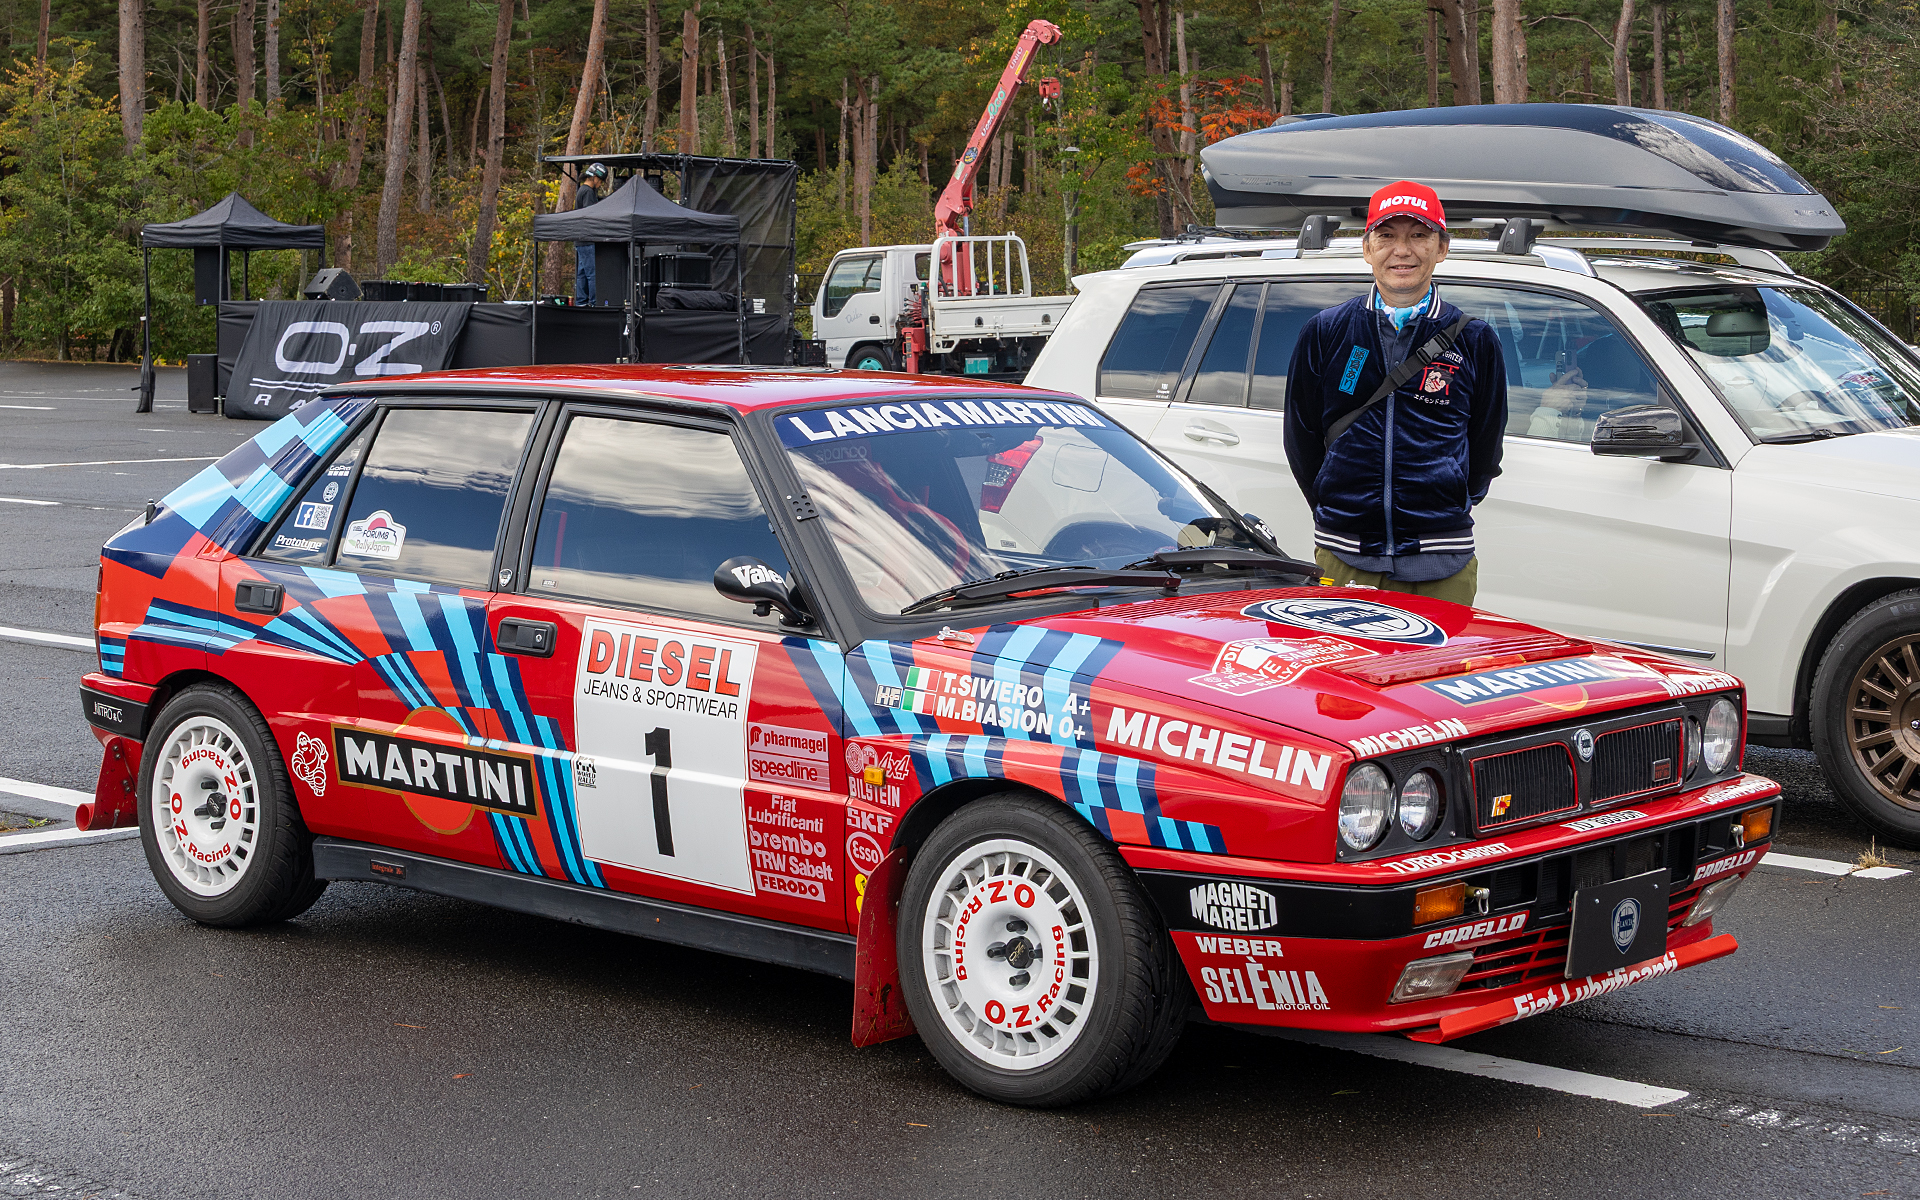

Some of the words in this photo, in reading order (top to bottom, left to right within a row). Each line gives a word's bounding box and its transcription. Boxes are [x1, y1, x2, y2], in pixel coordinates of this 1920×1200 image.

[1010, 47, 1023, 69] UNIC
[1379, 196, 1428, 211] MOTUL
[789, 402, 953, 442] LANCIA
[943, 401, 1107, 428] MARTINI
[275, 534, 322, 552] Prototype
[731, 565, 788, 589] Vale
[587, 629, 741, 697] DIESEL
[1278, 643, 1354, 661] SANREMO
[1216, 660, 1282, 689] RALLYE
[1255, 661, 1302, 687] RALLYE
[1434, 661, 1611, 700] MARTINI
[1657, 674, 1739, 697] MICHELIN
[584, 678, 628, 700] JEANS
[632, 686, 642, 703] &
[646, 688, 738, 719] SPORTWEAR
[1061, 692, 1091, 715] A+
[764, 731, 827, 753] pharmagel
[1106, 707, 1332, 790] MICHELIN
[1349, 718, 1469, 758] MICHELIN
[343, 736, 527, 806] MARTINI
[752, 758, 818, 782] speedline
[878, 751, 911, 780] 4x4
[645, 726, 675, 858] 1
[771, 795, 796, 813] Fiat
[849, 776, 900, 807] BILSTEIN
[748, 806, 823, 833] Lubrificanti
[847, 807, 893, 834] SKF
[749, 825, 826, 858] brembo
[752, 849, 786, 872] TRW
[789, 857, 833, 881] Sabelt
[1694, 849, 1757, 881] CARELLO
[760, 876, 819, 897] FERODO
[1190, 883, 1278, 912] MAGNETI
[1190, 900, 1278, 931] MARELLI
[1423, 913, 1527, 949] CARELLO
[1195, 936, 1284, 957] WEBER
[1201, 956, 1329, 1010] SELÈNIA
[1513, 986, 1558, 1021] Fiat
[1560, 951, 1679, 1008] Lubrificanti
[1275, 1003, 1311, 1011] MOTOR
